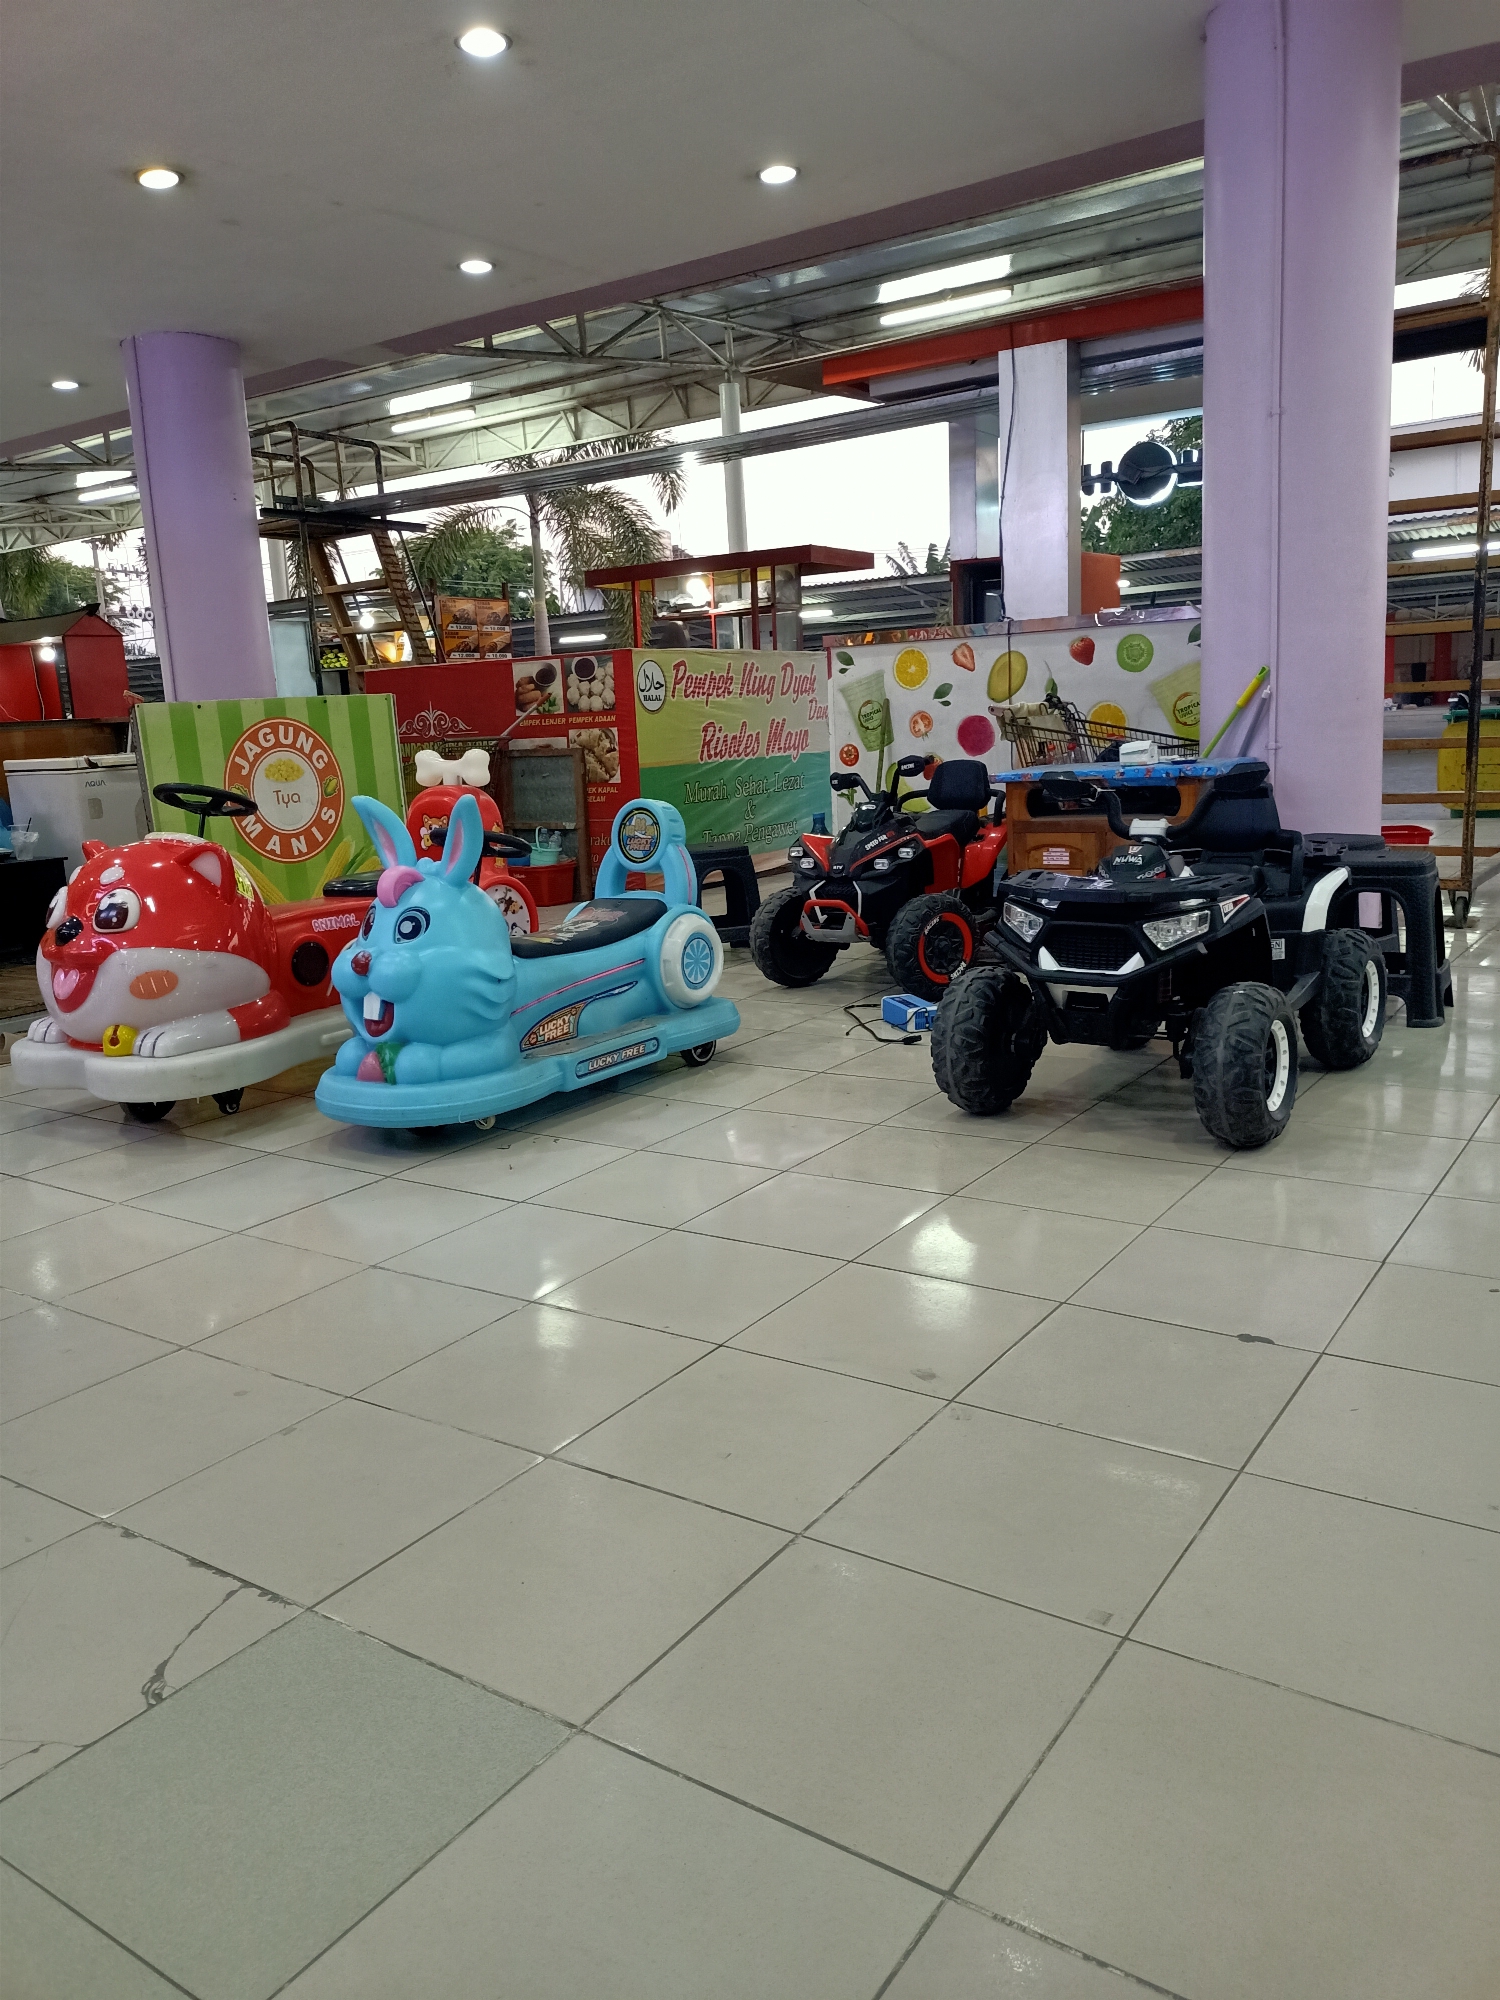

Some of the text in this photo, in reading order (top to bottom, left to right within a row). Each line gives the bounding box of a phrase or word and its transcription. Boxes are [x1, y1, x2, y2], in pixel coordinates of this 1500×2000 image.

[670, 660, 734, 707] Pempek
[738, 661, 776, 705] Ning
[643, 694, 663, 702] HALAL
[1176, 701, 1200, 714] TROPICA
[519, 717, 566, 727] EMPEK LENJER
[568, 715, 616, 724] PEMPEK ADAAN
[234, 724, 329, 776] JAGUNG
[698, 717, 809, 764] Risoles Mayo
[85, 779, 106, 788] AQUA
[598, 786, 619, 794] KAPAL
[774, 771, 805, 792] Lezat
[273, 789, 301, 808] Tya
[744, 799, 756, 820] &
[240, 806, 336, 856] MANIS
[743, 819, 799, 844] Pengawet
[626, 837, 653, 845] LUCKY
[628, 843, 651, 851] FREE
[312, 912, 360, 932] ANIMAL
[539, 1013, 571, 1035] LUCKY
[544, 1023, 570, 1042] FREE
[588, 1044, 646, 1070] LUCKY FREE
